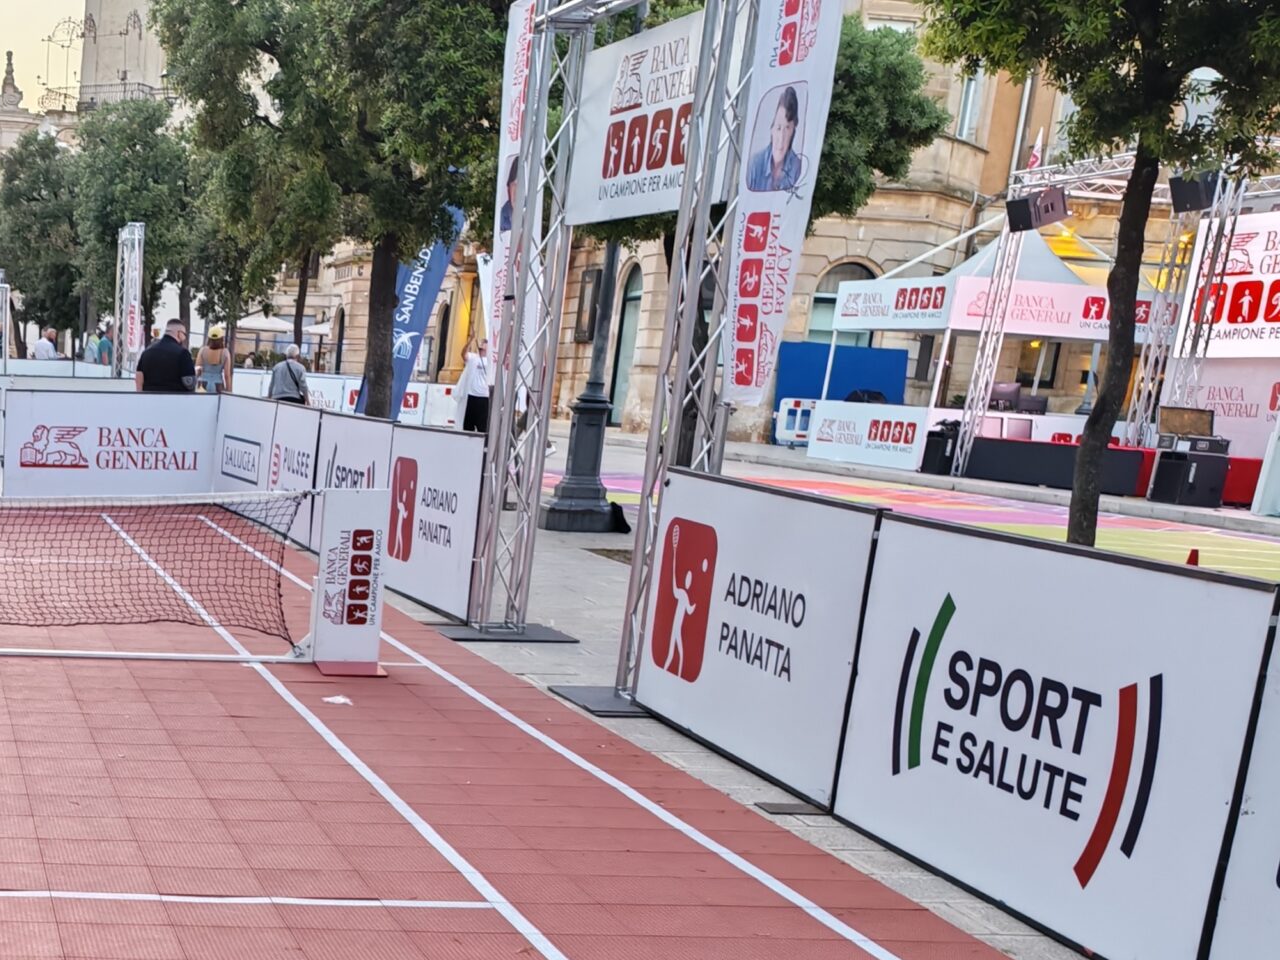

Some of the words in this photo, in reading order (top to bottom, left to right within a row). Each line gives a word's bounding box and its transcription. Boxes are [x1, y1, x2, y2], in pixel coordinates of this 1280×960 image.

[648, 35, 690, 75] BANCA
[598, 184, 610, 200] UN
[610, 177, 646, 199] CAMPIONE
[647, 175, 660, 193] PER
[662, 170, 684, 190] AMIC
[395, 293, 417, 324] SAN
[1011, 308, 1072, 325] GENERALI
[1013, 293, 1056, 310] BANCA
[1080, 321, 1091, 329] UN
[1207, 386, 1244, 401] BANCA
[97, 427, 169, 448] BANCA
[96, 450, 199, 471] GENERALI
[224, 446, 256, 473] SALUGEA
[283, 447, 310, 479] PULSEE
[334, 465, 365, 488] SPORT
[420, 486, 458, 514] ADRIANO
[418, 518, 452, 548] PANATTA
[325, 547, 338, 585] BANCA
[337, 530, 351, 586] GENERALI
[370, 572, 379, 612] CAMPIONE
[724, 572, 806, 629] ADRIANO
[368, 613, 375, 626] UN
[719, 621, 792, 683] PANATTA
[943, 649, 1102, 756] SPORT
[931, 721, 954, 765] E
[956, 734, 1088, 822] SALUTE
